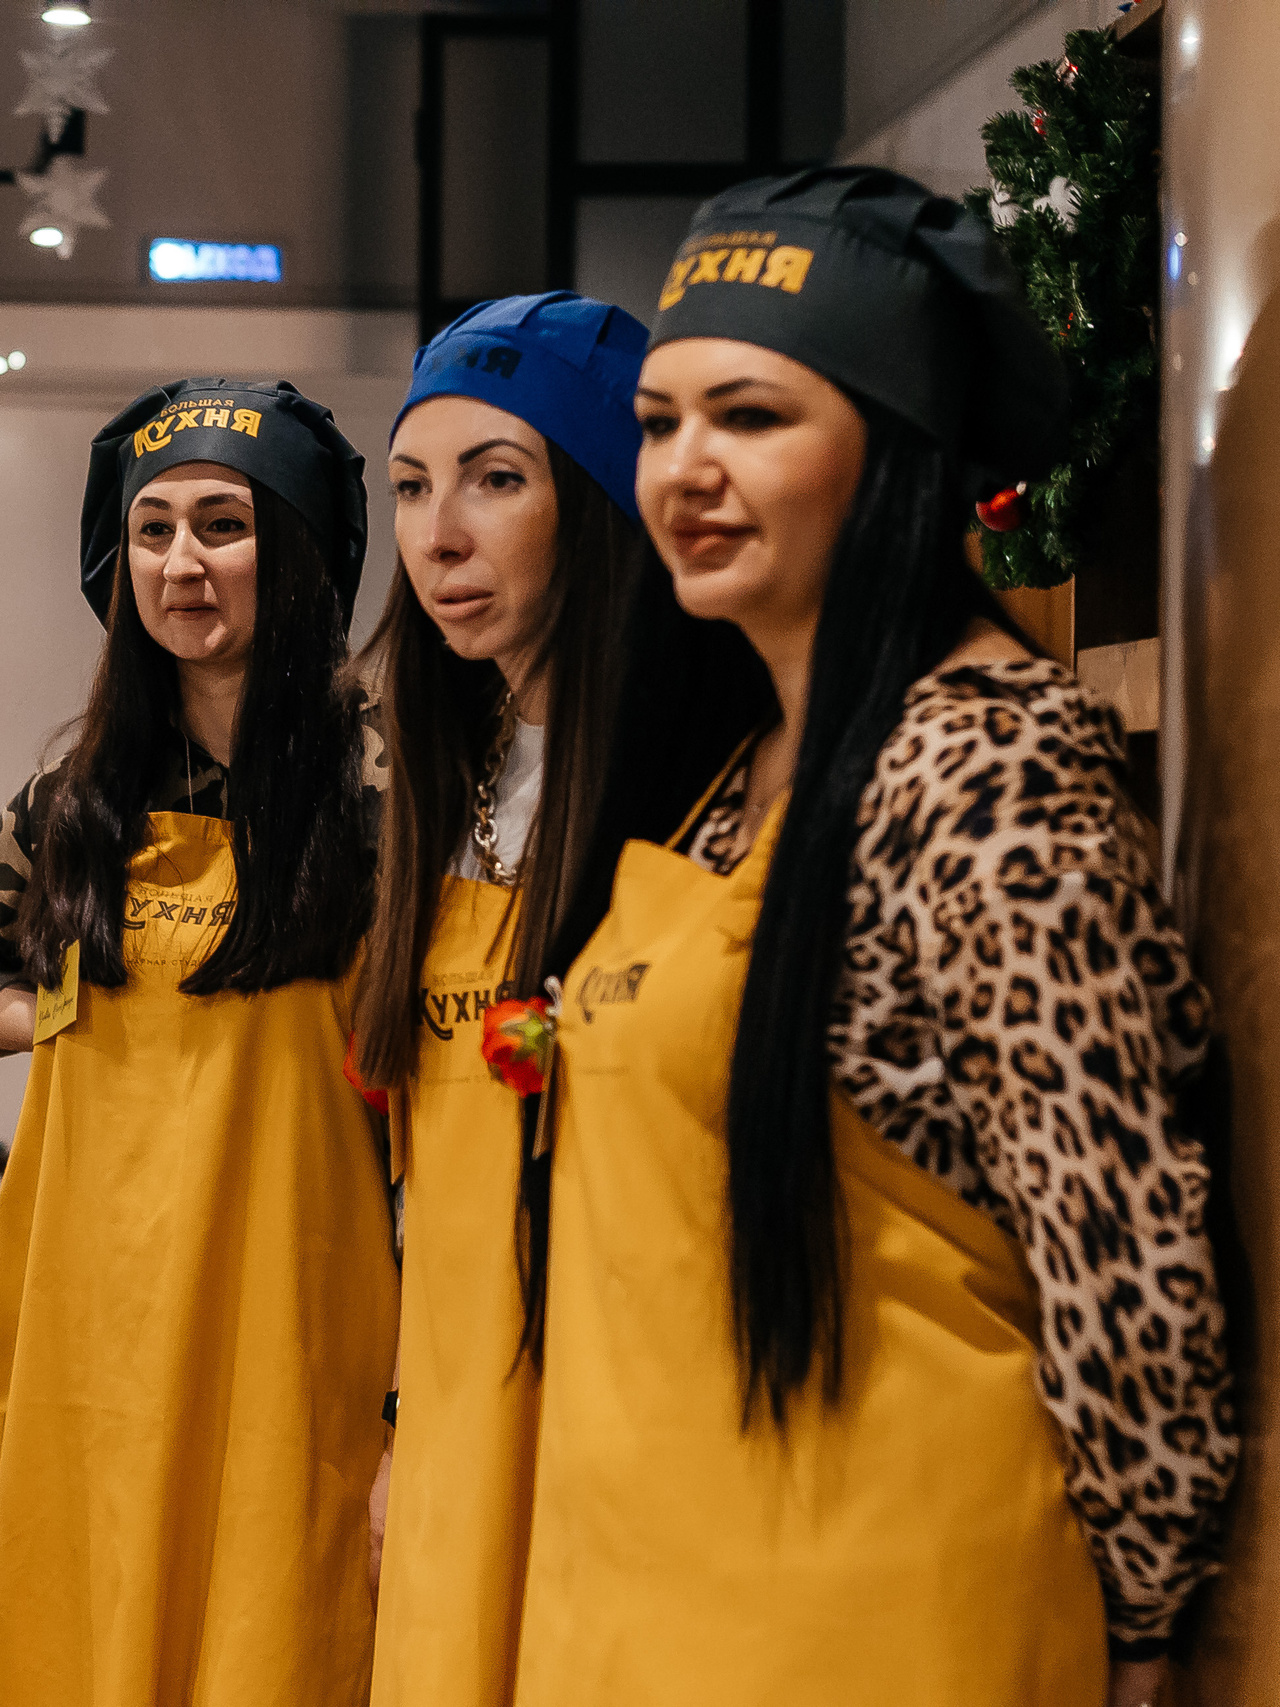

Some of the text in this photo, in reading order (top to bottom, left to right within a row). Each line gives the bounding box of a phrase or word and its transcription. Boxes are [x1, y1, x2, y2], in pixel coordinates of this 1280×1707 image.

[658, 244, 815, 312] УХНЯ
[160, 397, 235, 418] БОЛЬШАЯ
[133, 408, 262, 458] КУХНЯ
[122, 897, 237, 930] УХНЯ
